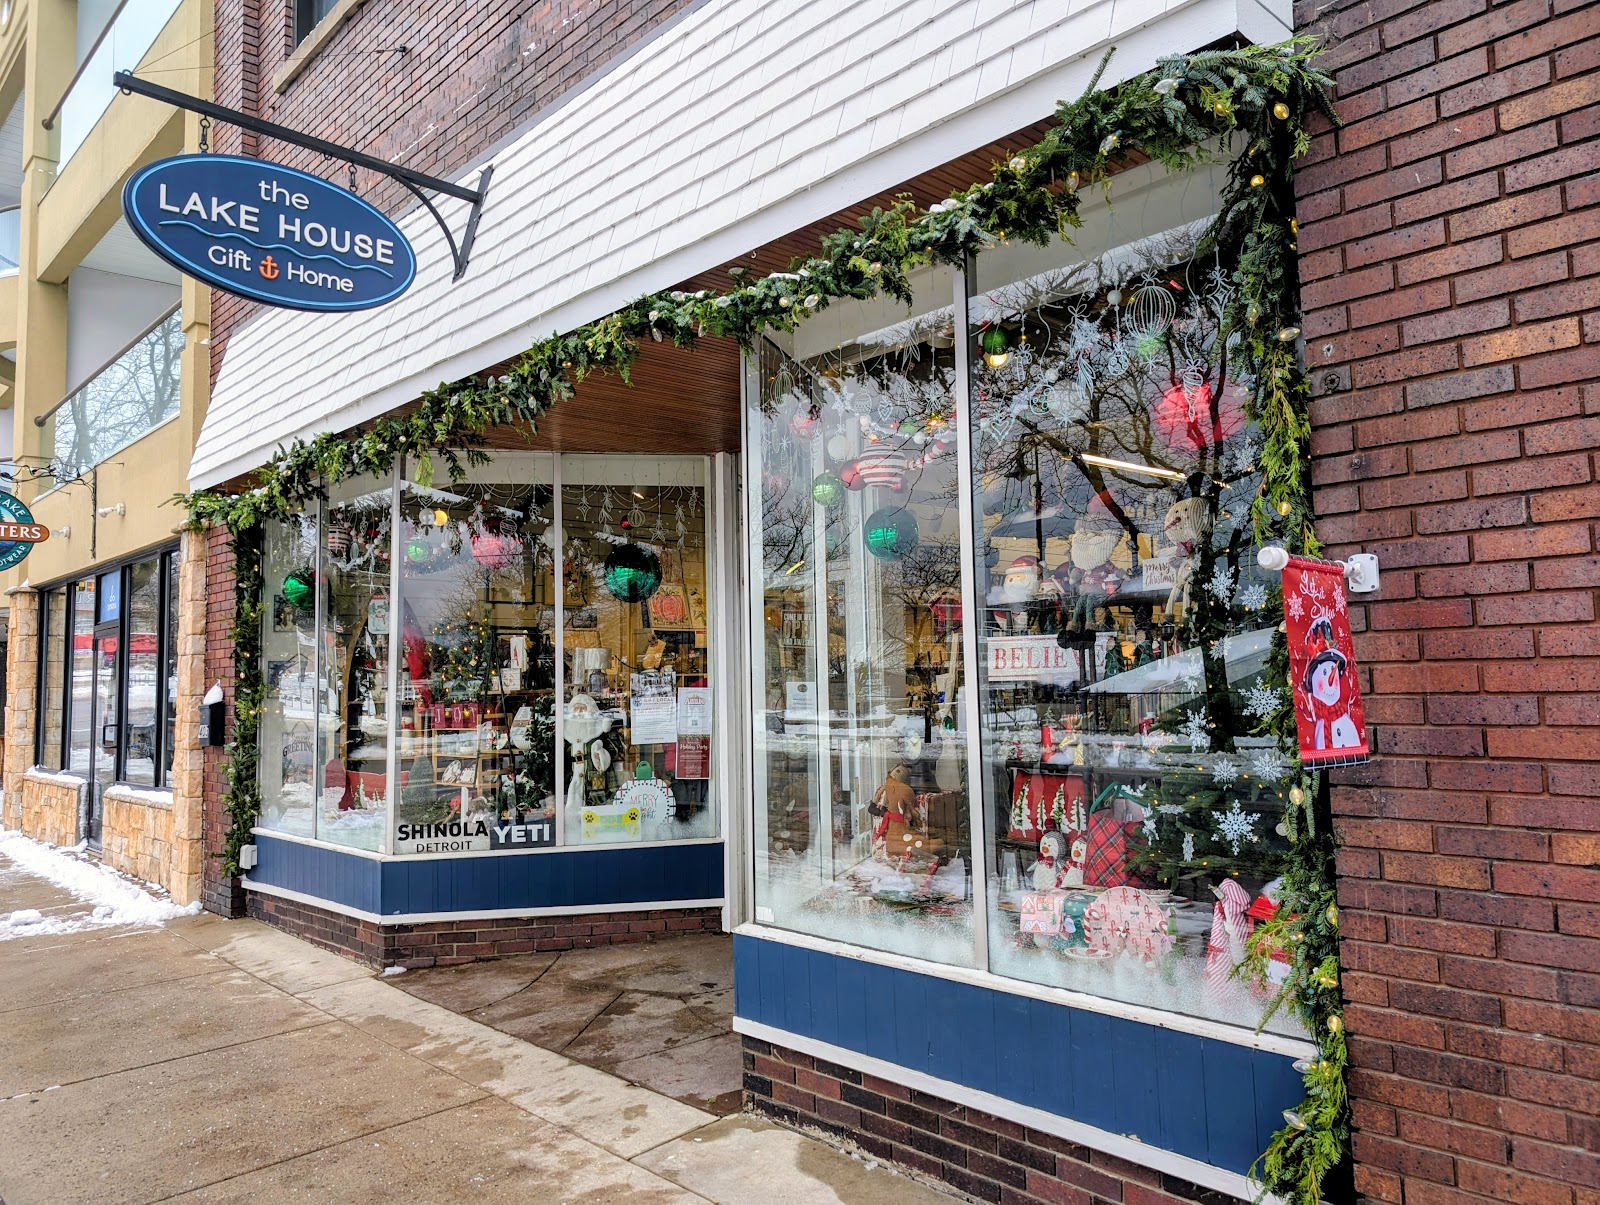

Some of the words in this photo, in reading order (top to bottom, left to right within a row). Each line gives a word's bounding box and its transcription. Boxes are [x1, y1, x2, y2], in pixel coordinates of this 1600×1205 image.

[258, 180, 310, 210] the
[159, 183, 260, 233] LAKE
[278, 213, 394, 265] HOUSE
[208, 245, 252, 272] Gift
[287, 261, 354, 293] Home
[0, 493, 26, 518] AKE
[1299, 570, 1316, 598] Let
[283, 742, 315, 757] GREETING
[397, 820, 489, 841] SHINOLA
[493, 823, 550, 844] YETI
[416, 841, 473, 853] DETROIT
